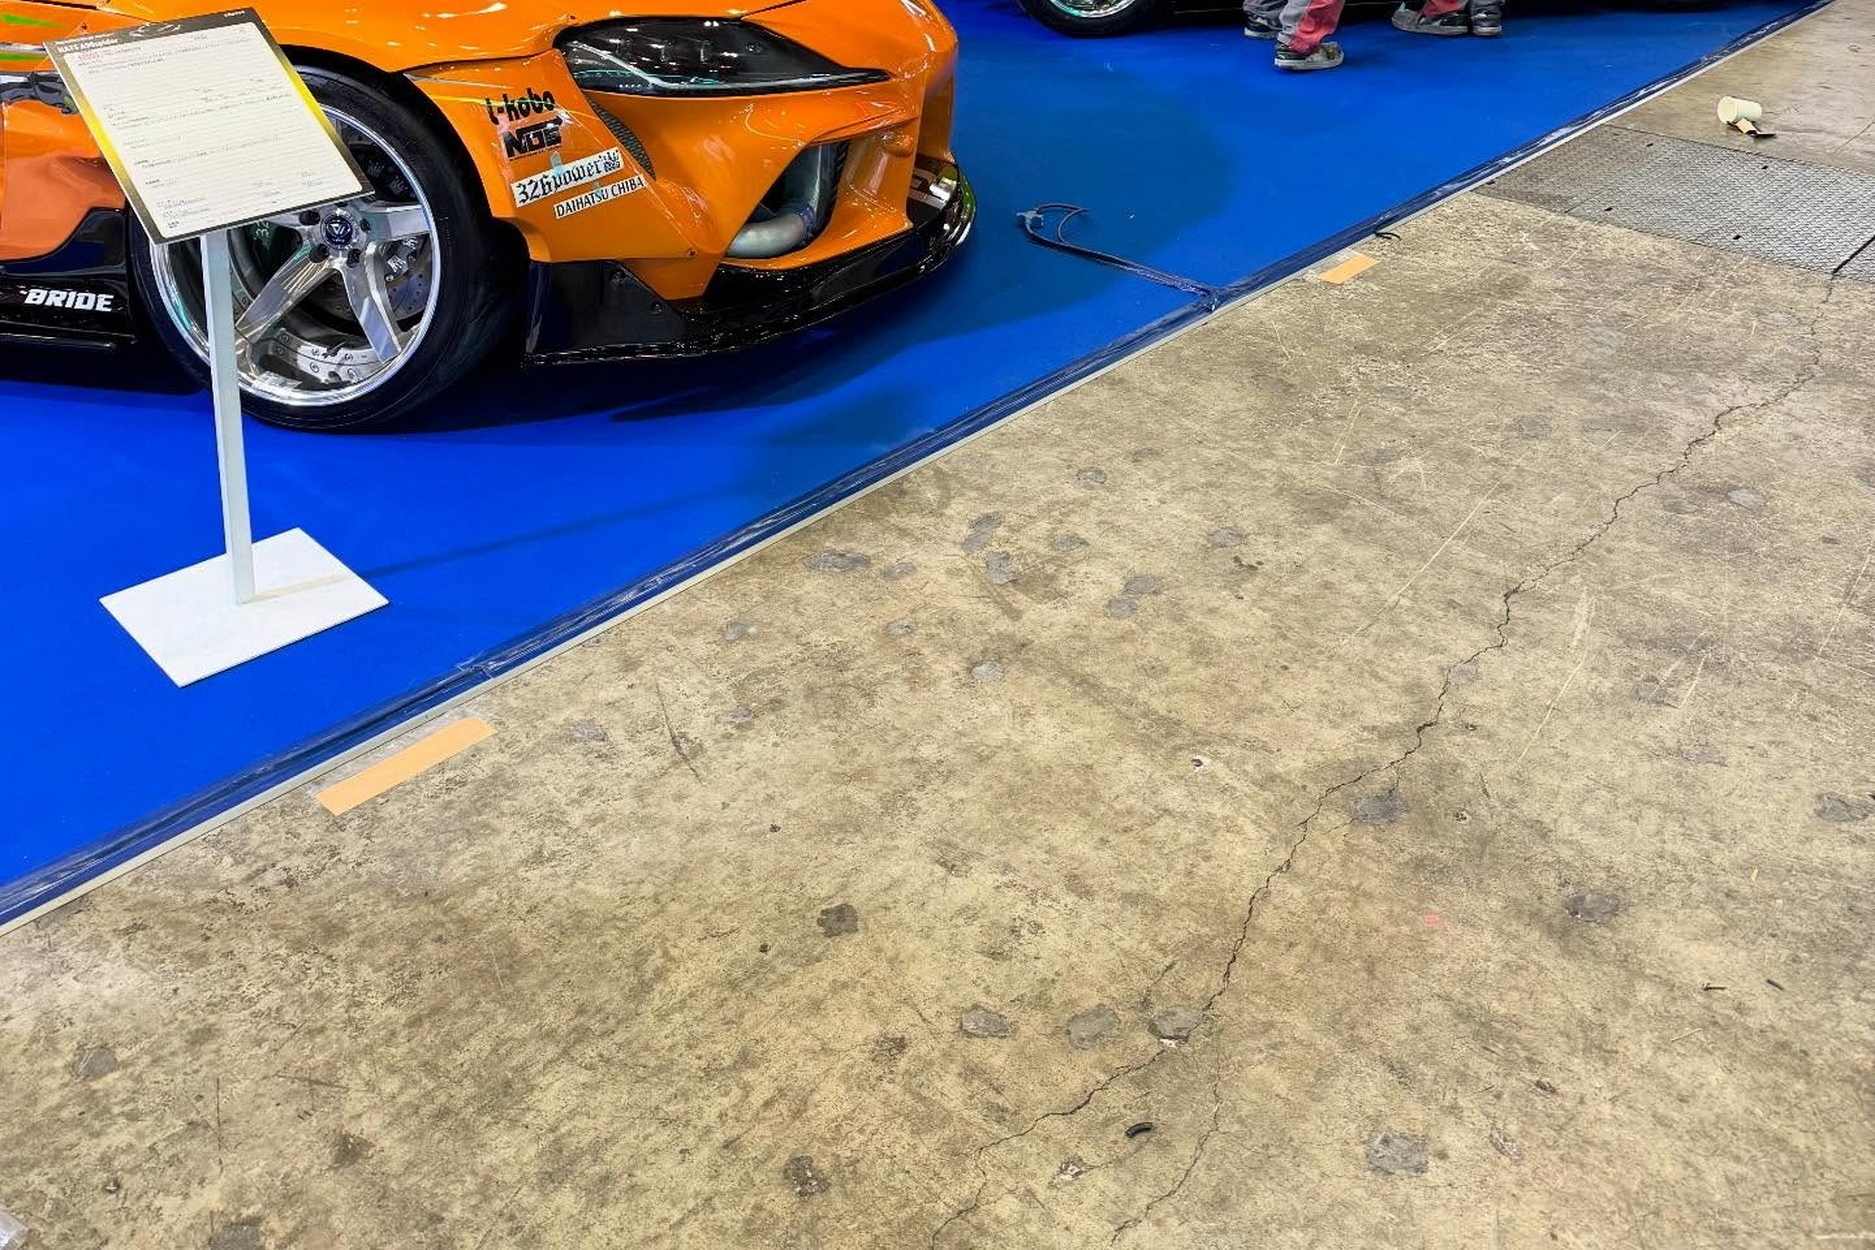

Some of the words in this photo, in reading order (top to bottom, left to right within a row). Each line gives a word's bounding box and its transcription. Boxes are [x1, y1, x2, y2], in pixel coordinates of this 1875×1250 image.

[555, 188, 609, 217] DAIHATSU
[610, 176, 645, 198] CHIBA
[24, 288, 114, 312] BRIDE
